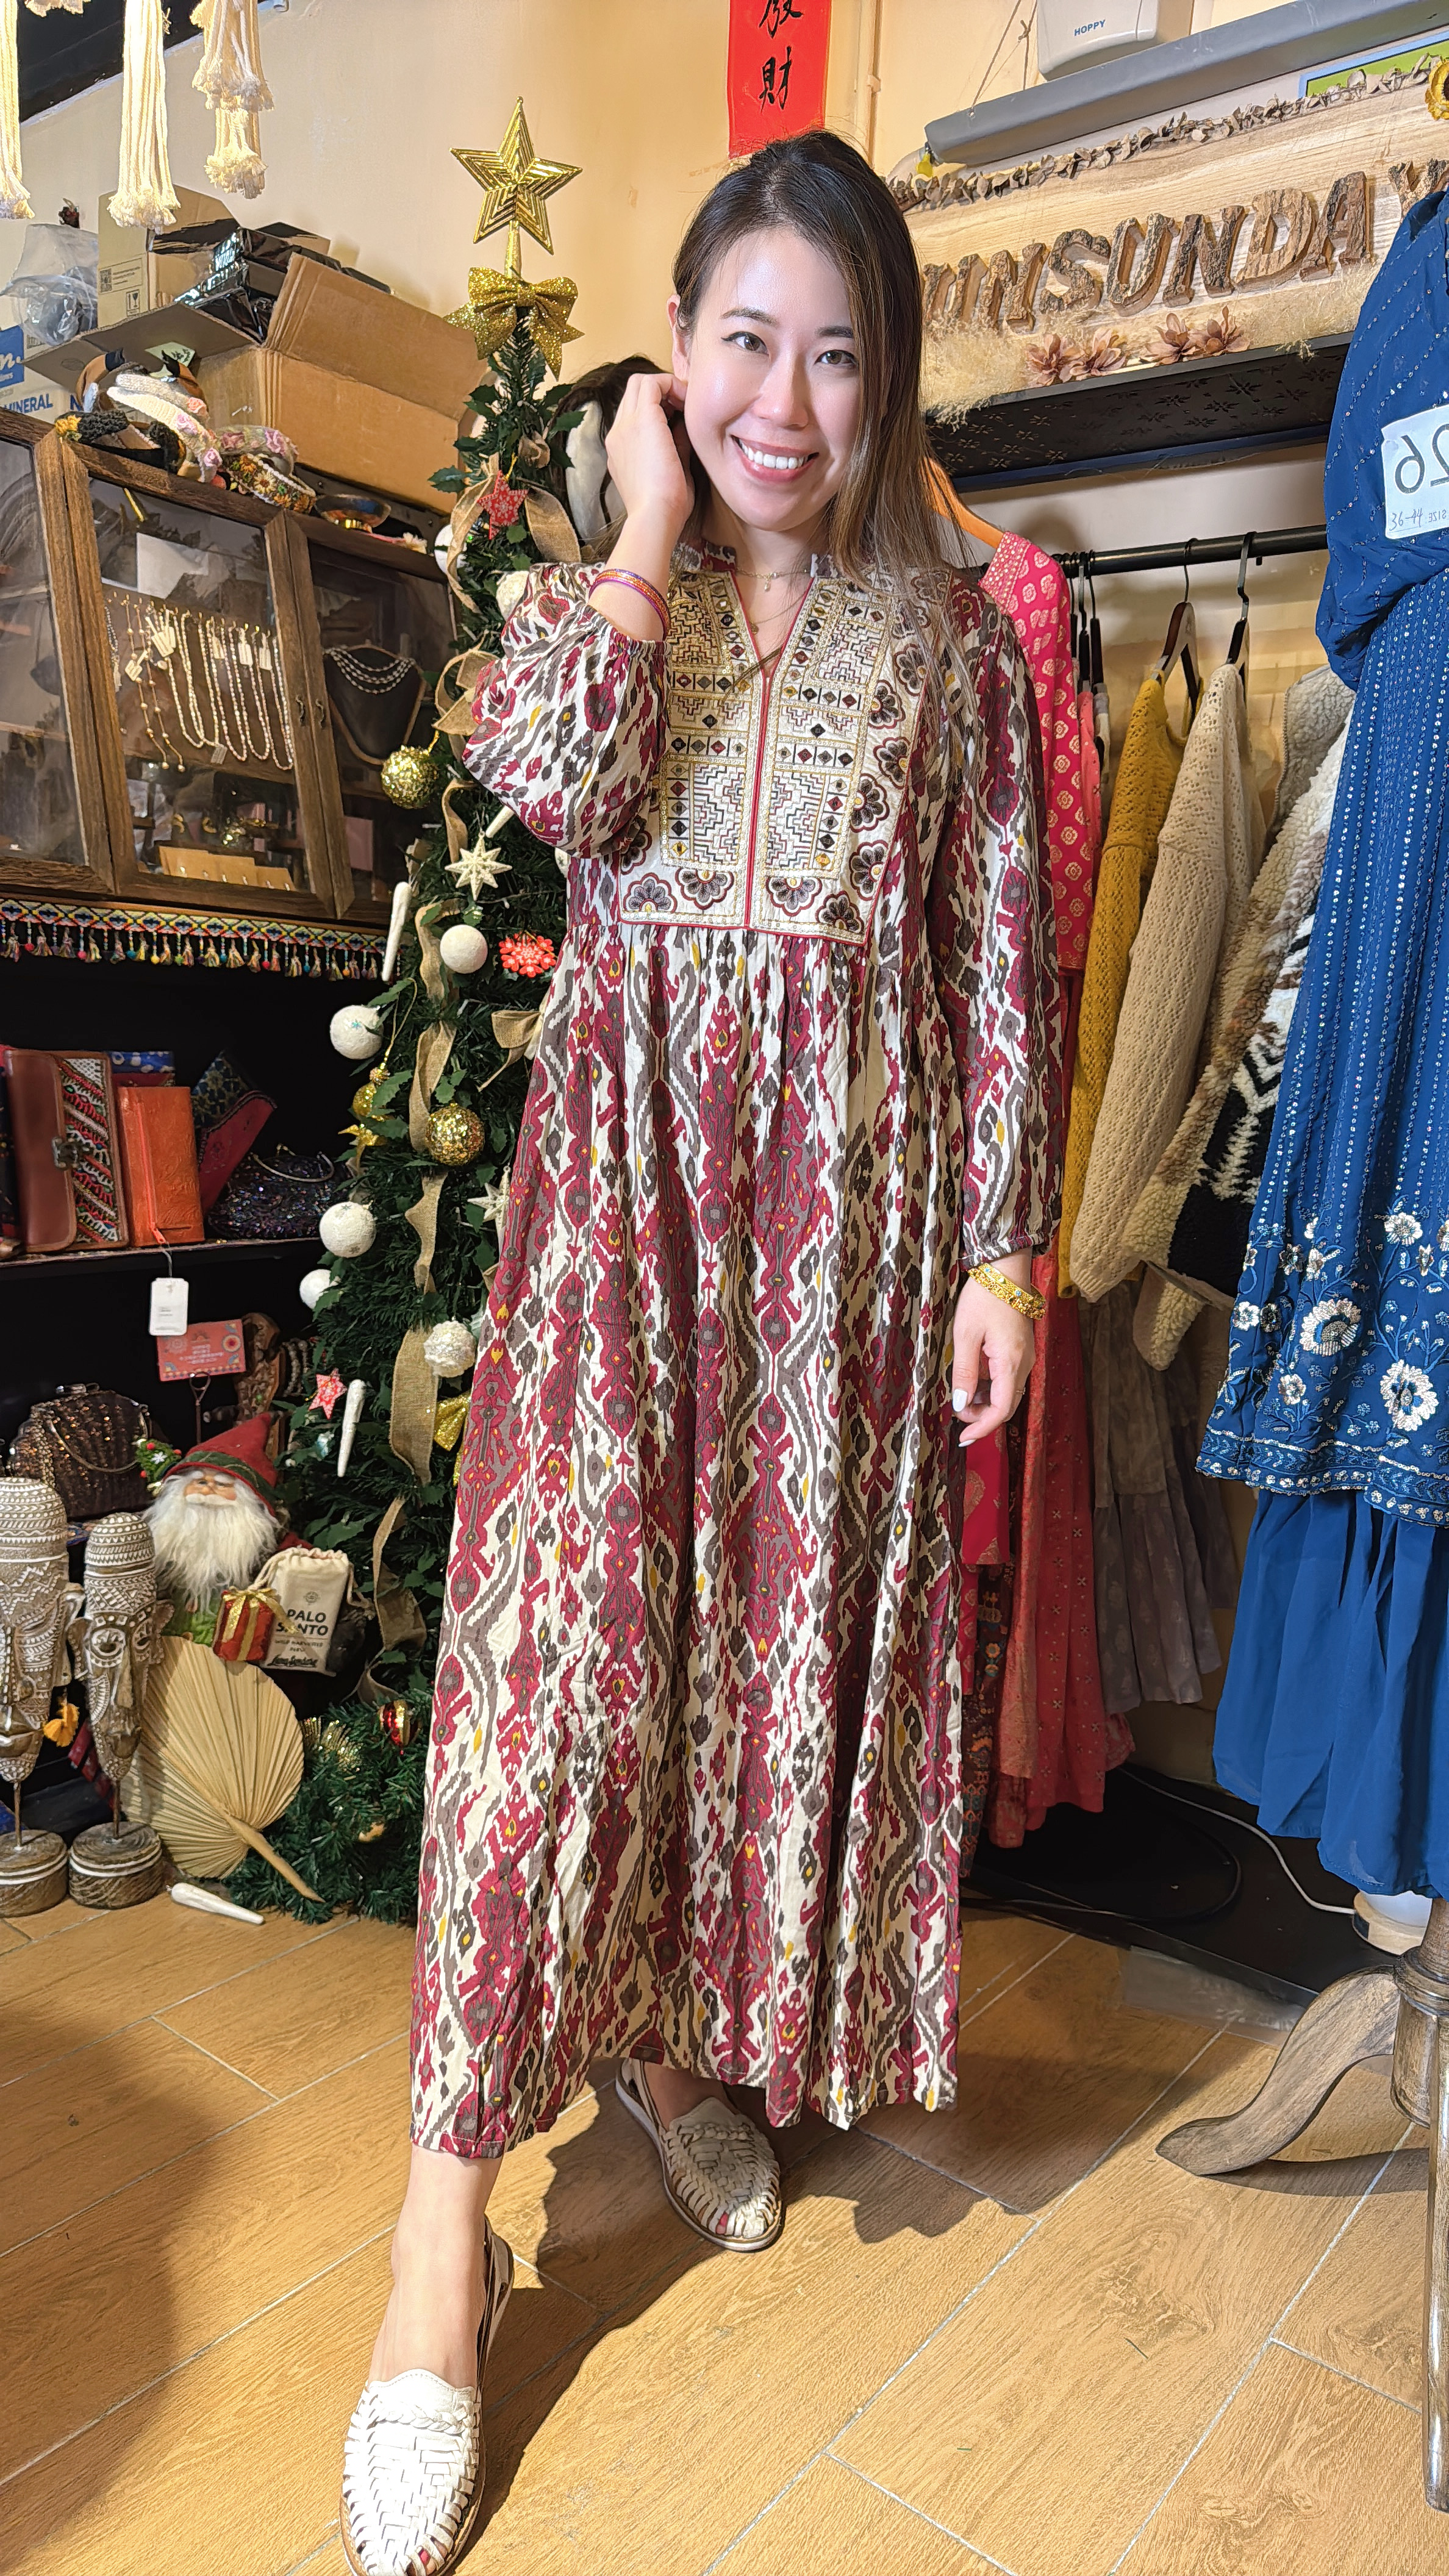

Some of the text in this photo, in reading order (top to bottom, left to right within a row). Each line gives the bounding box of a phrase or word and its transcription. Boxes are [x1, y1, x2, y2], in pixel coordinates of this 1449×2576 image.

[1074, 19, 1106, 37] HOPPY
[287, 1609, 326, 1623] PALO
[276, 1622, 329, 1636] SNTO
